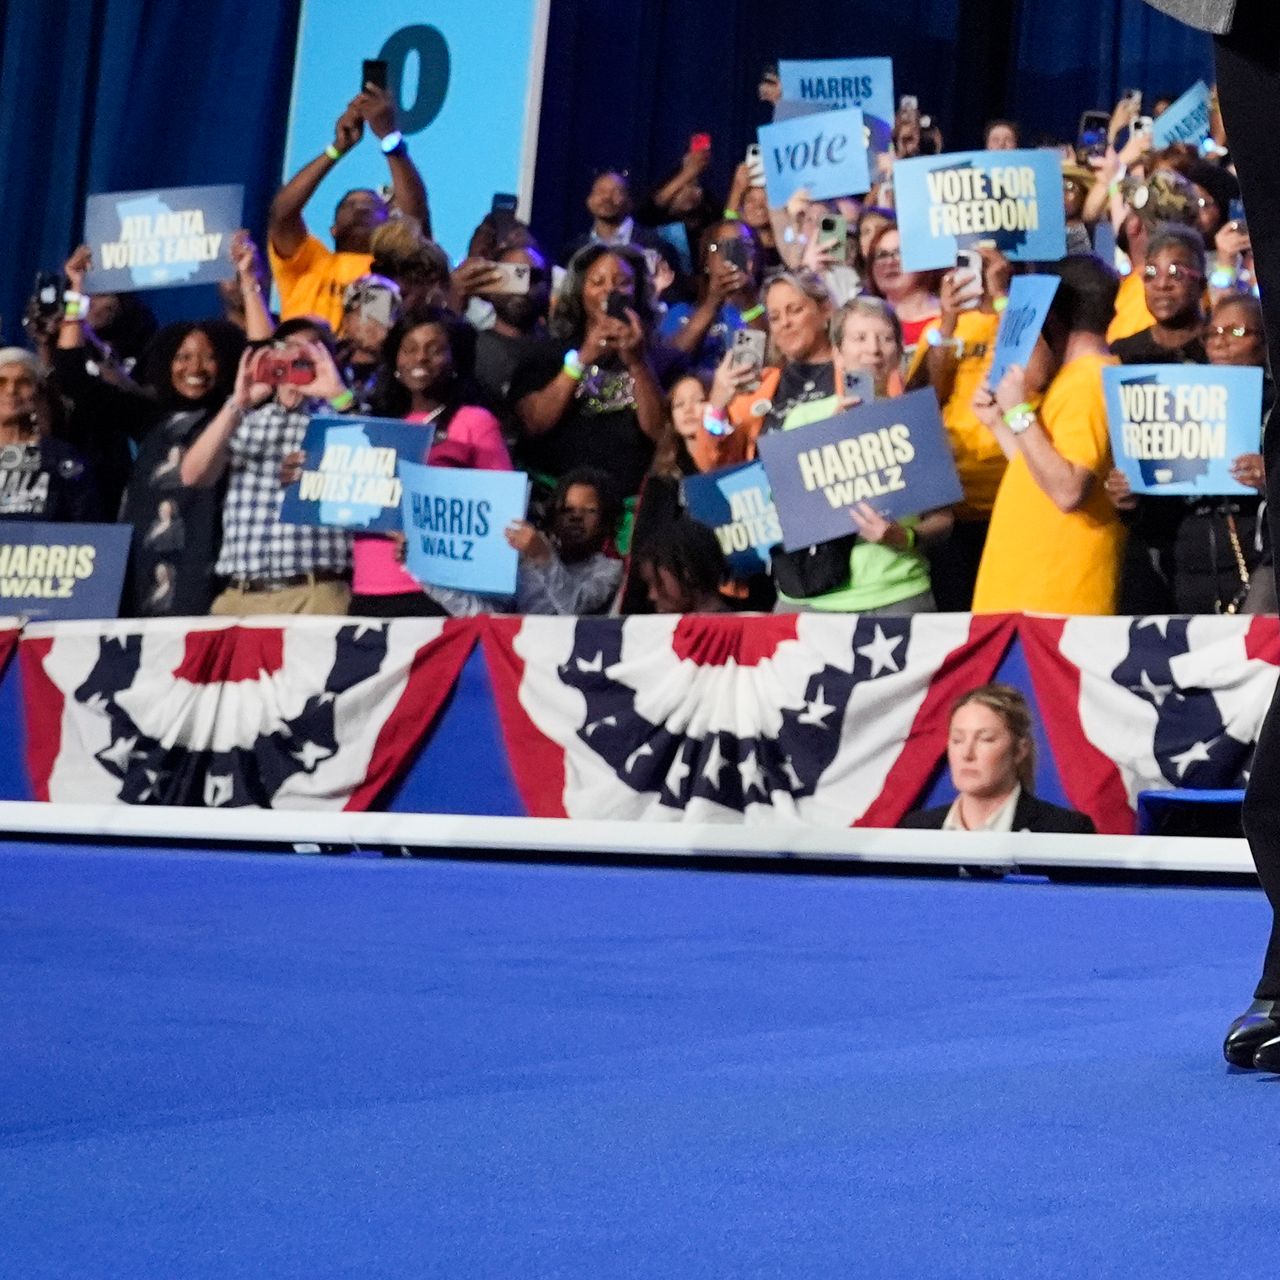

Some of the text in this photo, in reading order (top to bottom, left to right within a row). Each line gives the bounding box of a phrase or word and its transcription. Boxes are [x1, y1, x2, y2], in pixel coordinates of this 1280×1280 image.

[800, 75, 873, 99] HARRIS
[774, 131, 847, 174] vote
[927, 166, 1036, 204] VOTE FOR
[120, 209, 205, 242] ATLANTA
[930, 198, 1039, 239] FREEDOM
[101, 233, 222, 270] VOTES EARLY
[1120, 384, 1228, 421] VOTE FOR
[798, 424, 915, 491] HARRIS
[1122, 421, 1227, 460] FREEDOM
[823, 465, 906, 509] WALZ
[411, 491, 493, 537] HARRIS
[420, 534, 474, 561] WALZ
[714, 515, 785, 556] VOTES
[0, 578, 76, 598] WALZ
